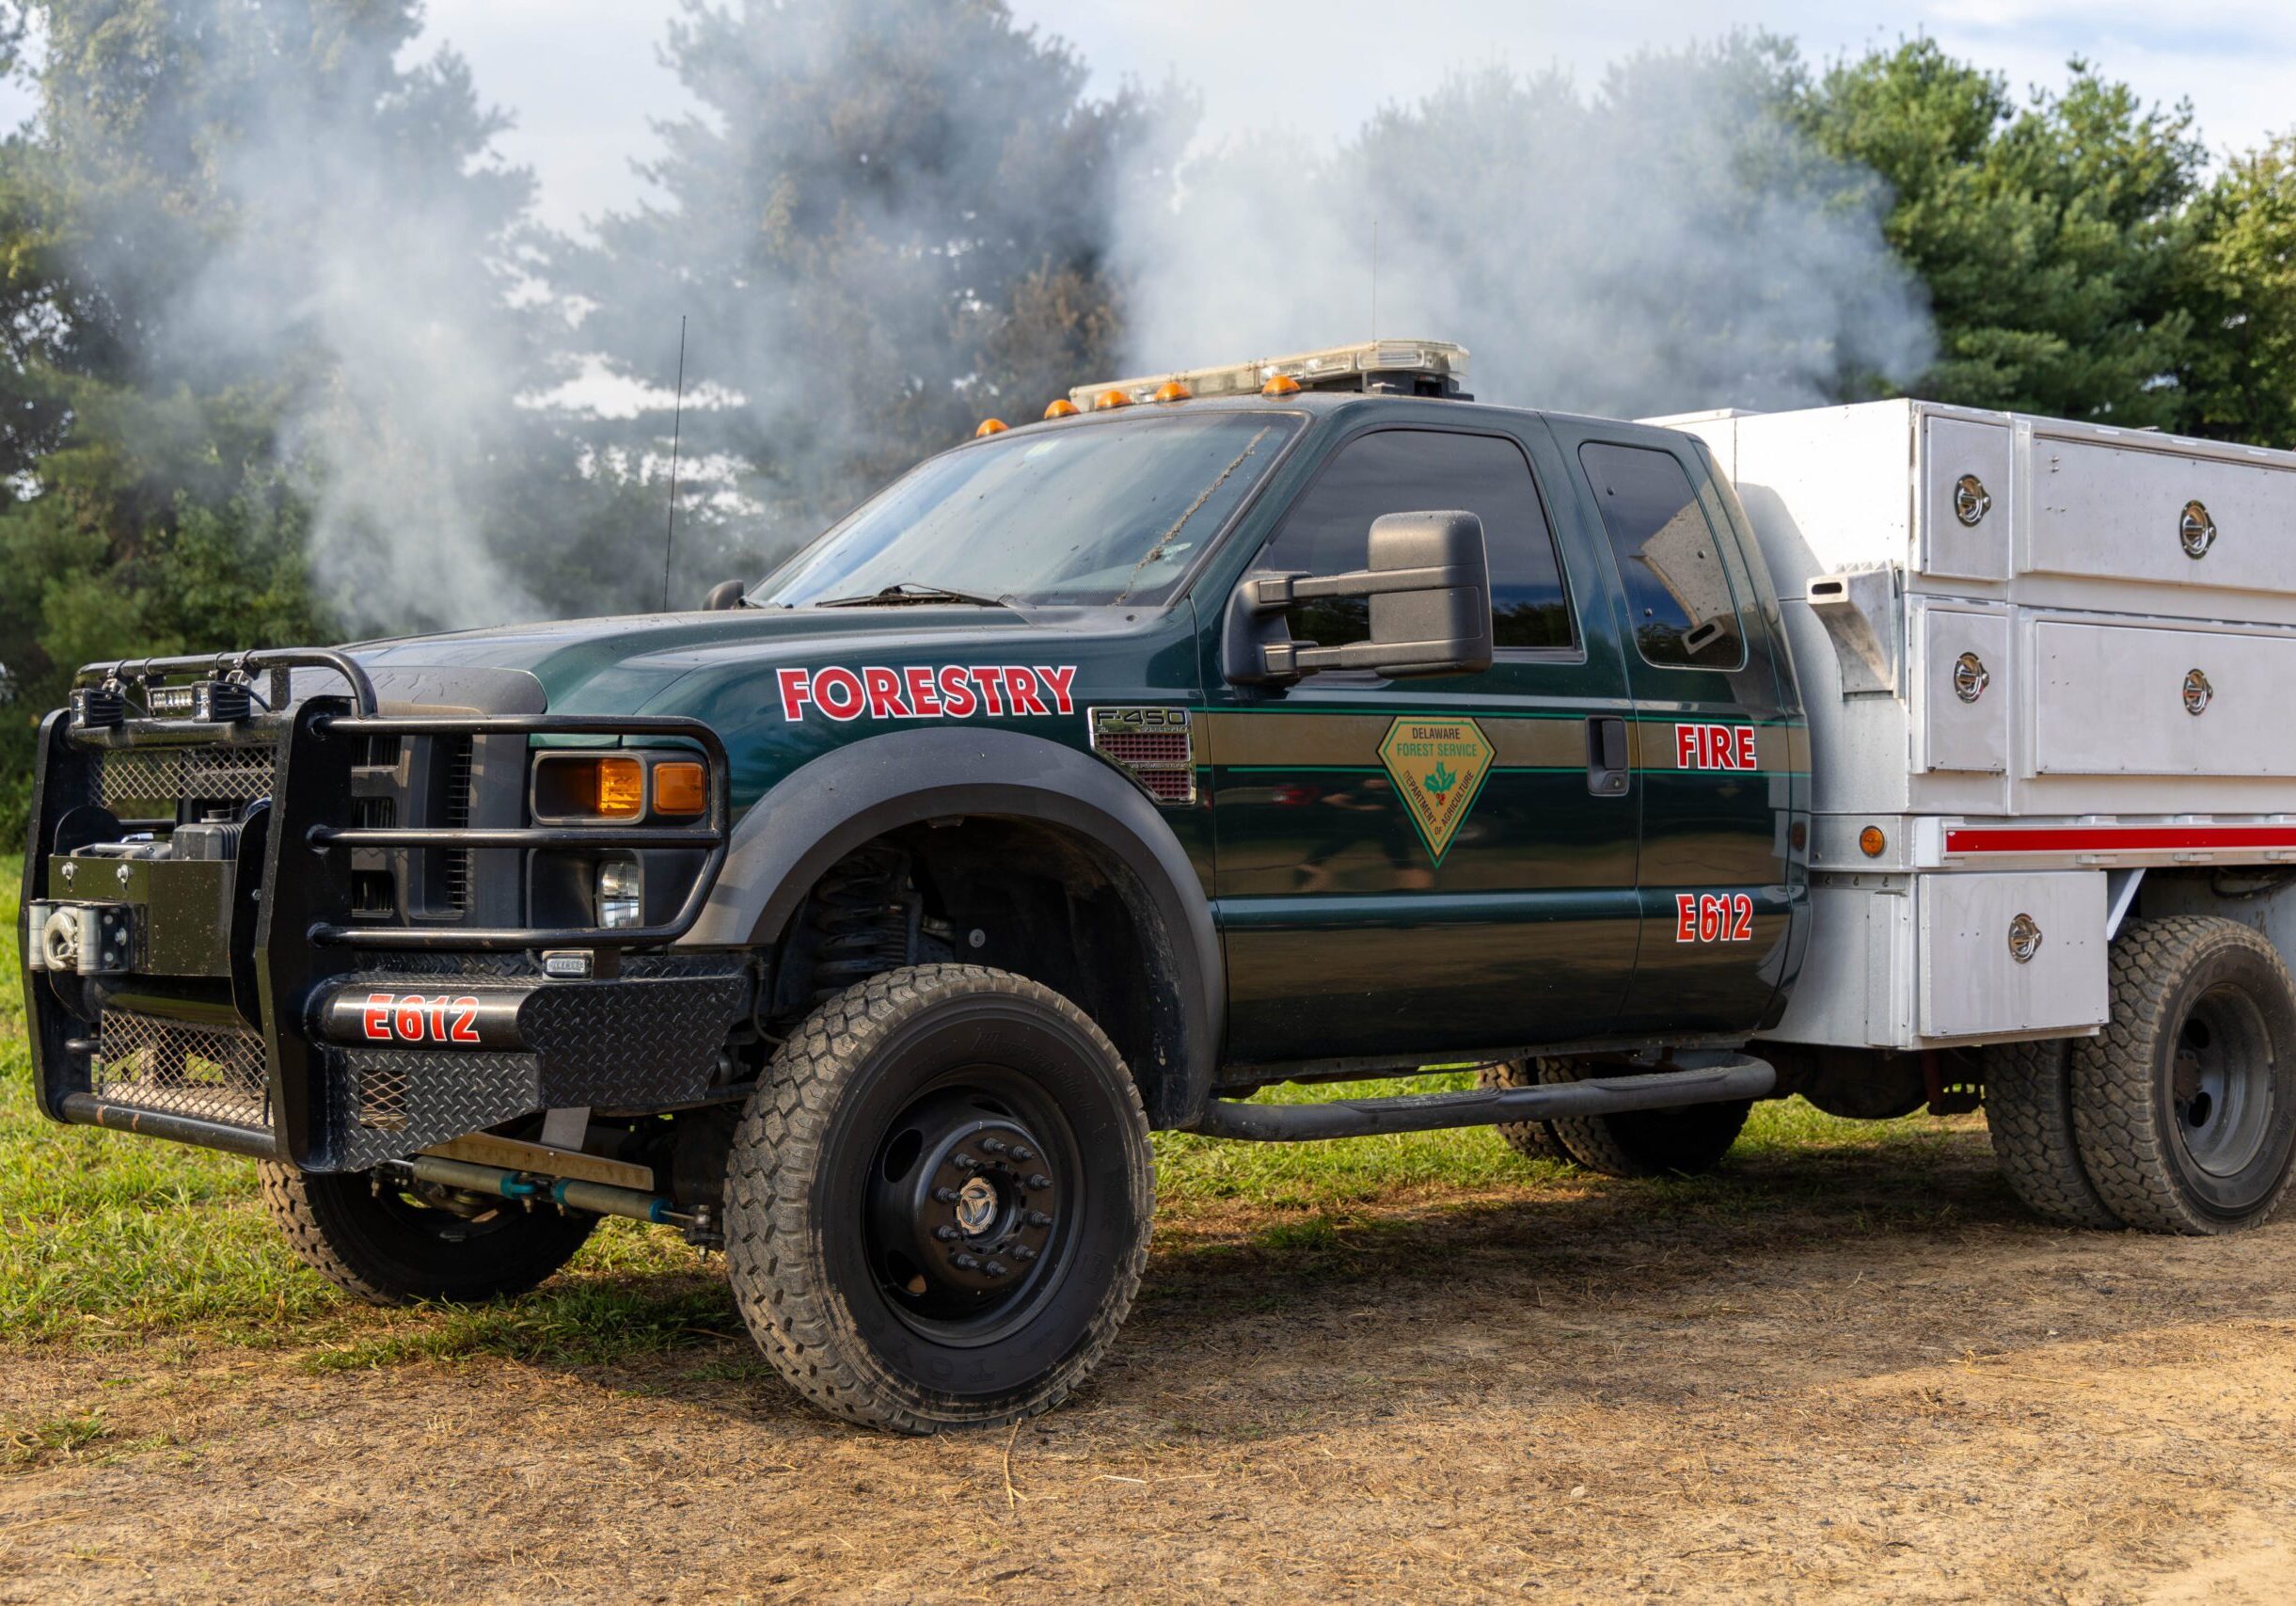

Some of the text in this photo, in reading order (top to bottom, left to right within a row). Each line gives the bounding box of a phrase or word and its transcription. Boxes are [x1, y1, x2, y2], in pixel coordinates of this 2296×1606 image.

[776, 665, 1078, 723] FORESTRY
[1096, 709, 1188, 725] F-450
[1396, 742, 1478, 757] FOREST SERVICE
[1411, 727, 1461, 740] DELAWARE
[1674, 723, 1757, 771] FIRE
[1402, 770, 1475, 835] DEPARTMENT OF AGRICULTURE
[1675, 894, 1753, 943] E612
[363, 993, 482, 1042] E612
